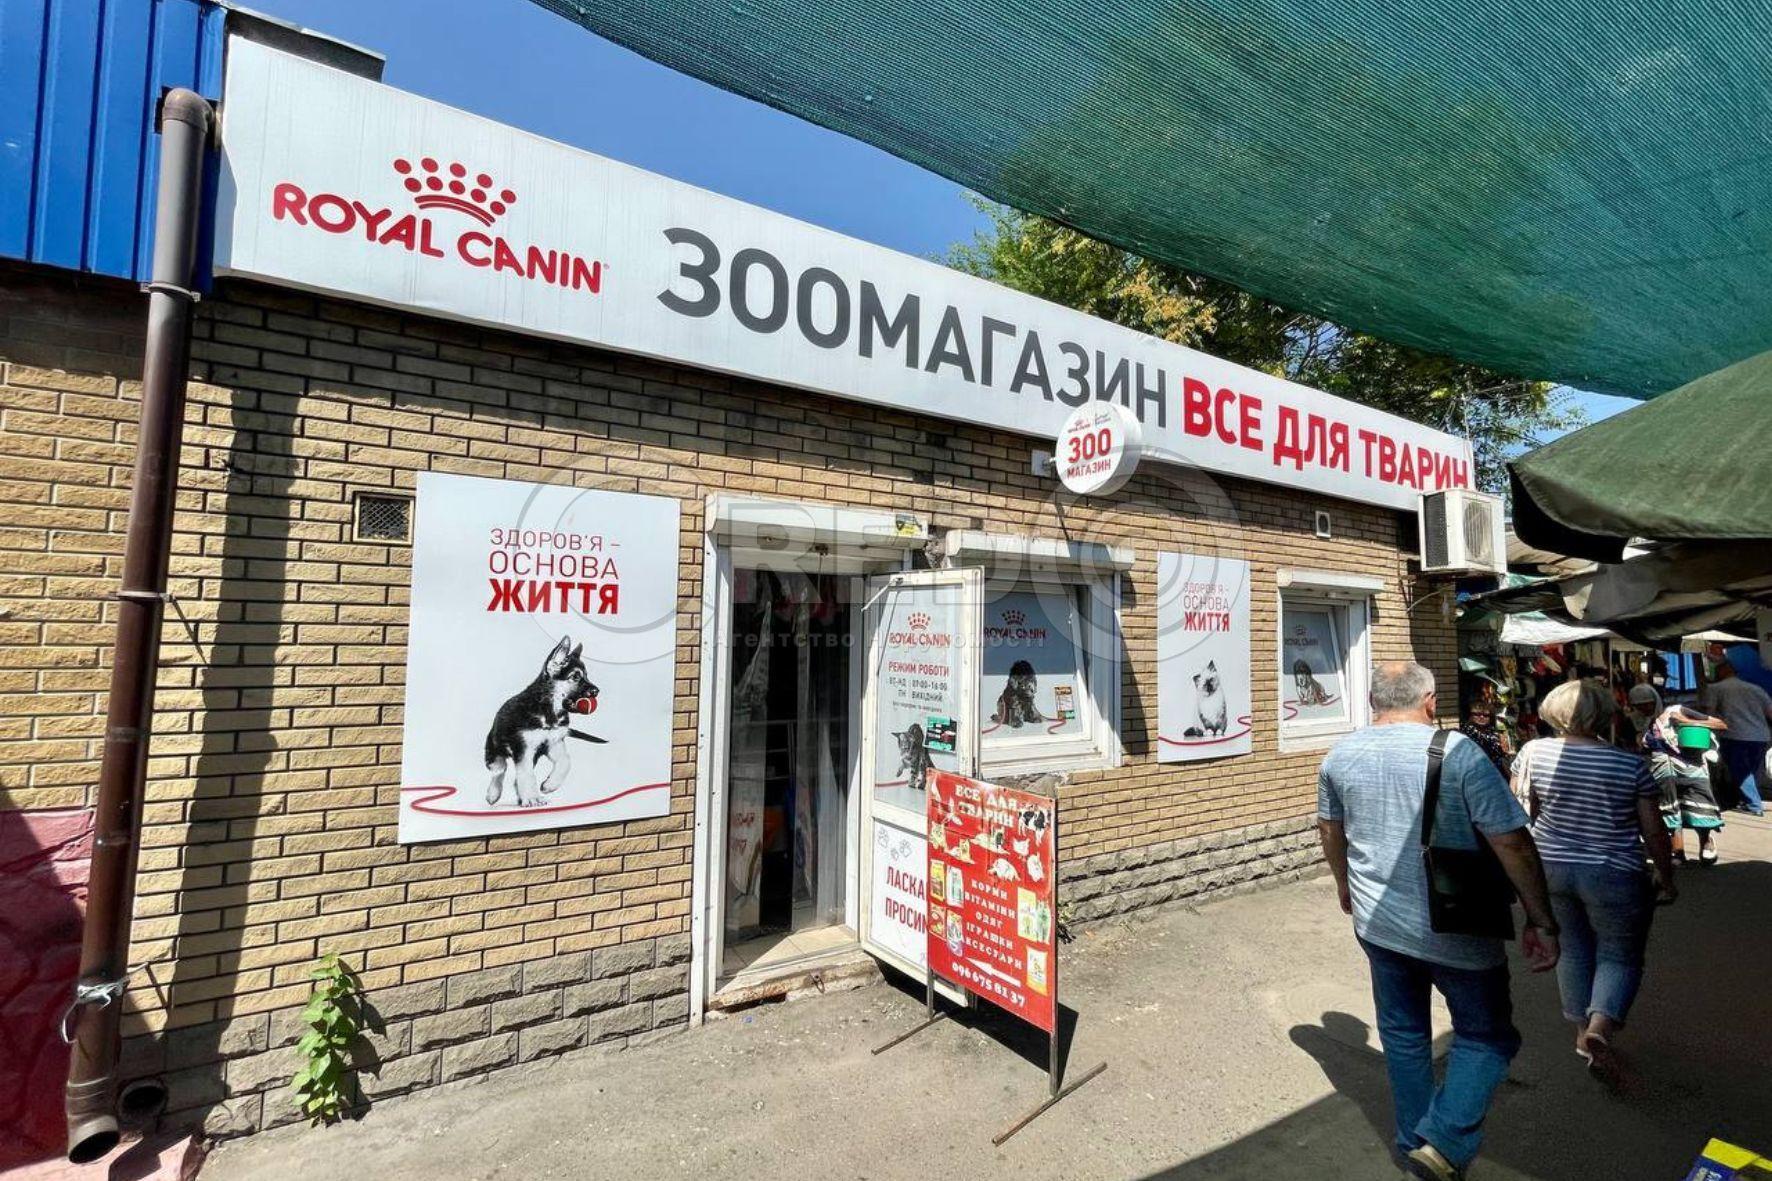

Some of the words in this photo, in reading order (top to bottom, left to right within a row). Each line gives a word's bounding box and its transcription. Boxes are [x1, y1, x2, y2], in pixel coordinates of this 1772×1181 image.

[273, 182, 444, 258] ROYAL
[456, 231, 602, 294] CANIN
[656, 227, 1167, 429] ЗООМАГАЗИН
[1183, 376, 1264, 452] ВСЕ
[1273, 404, 1350, 473] ДЛЯ
[1358, 428, 1469, 491] ТВАРИН
[1066, 458, 1111, 480] МАГАЗИН
[488, 551, 620, 580] ОСНОВА
[486, 578, 620, 615] ЖИТТЯ
[1183, 595, 1229, 611] ОСНОВА
[1183, 611, 1231, 632] ЖИТТЯ
[888, 632, 917, 645] ROYAL
[919, 633, 951, 646] CANIN
[985, 626, 1015, 639] ROYAL
[1016, 627, 1046, 640] CANIN
[888, 661, 916, 674] РЕЖИМ
[918, 664, 949, 678] РОБОТИ
[955, 783, 981, 801] ВСЕ
[886, 865, 926, 901] ЛАСКА
